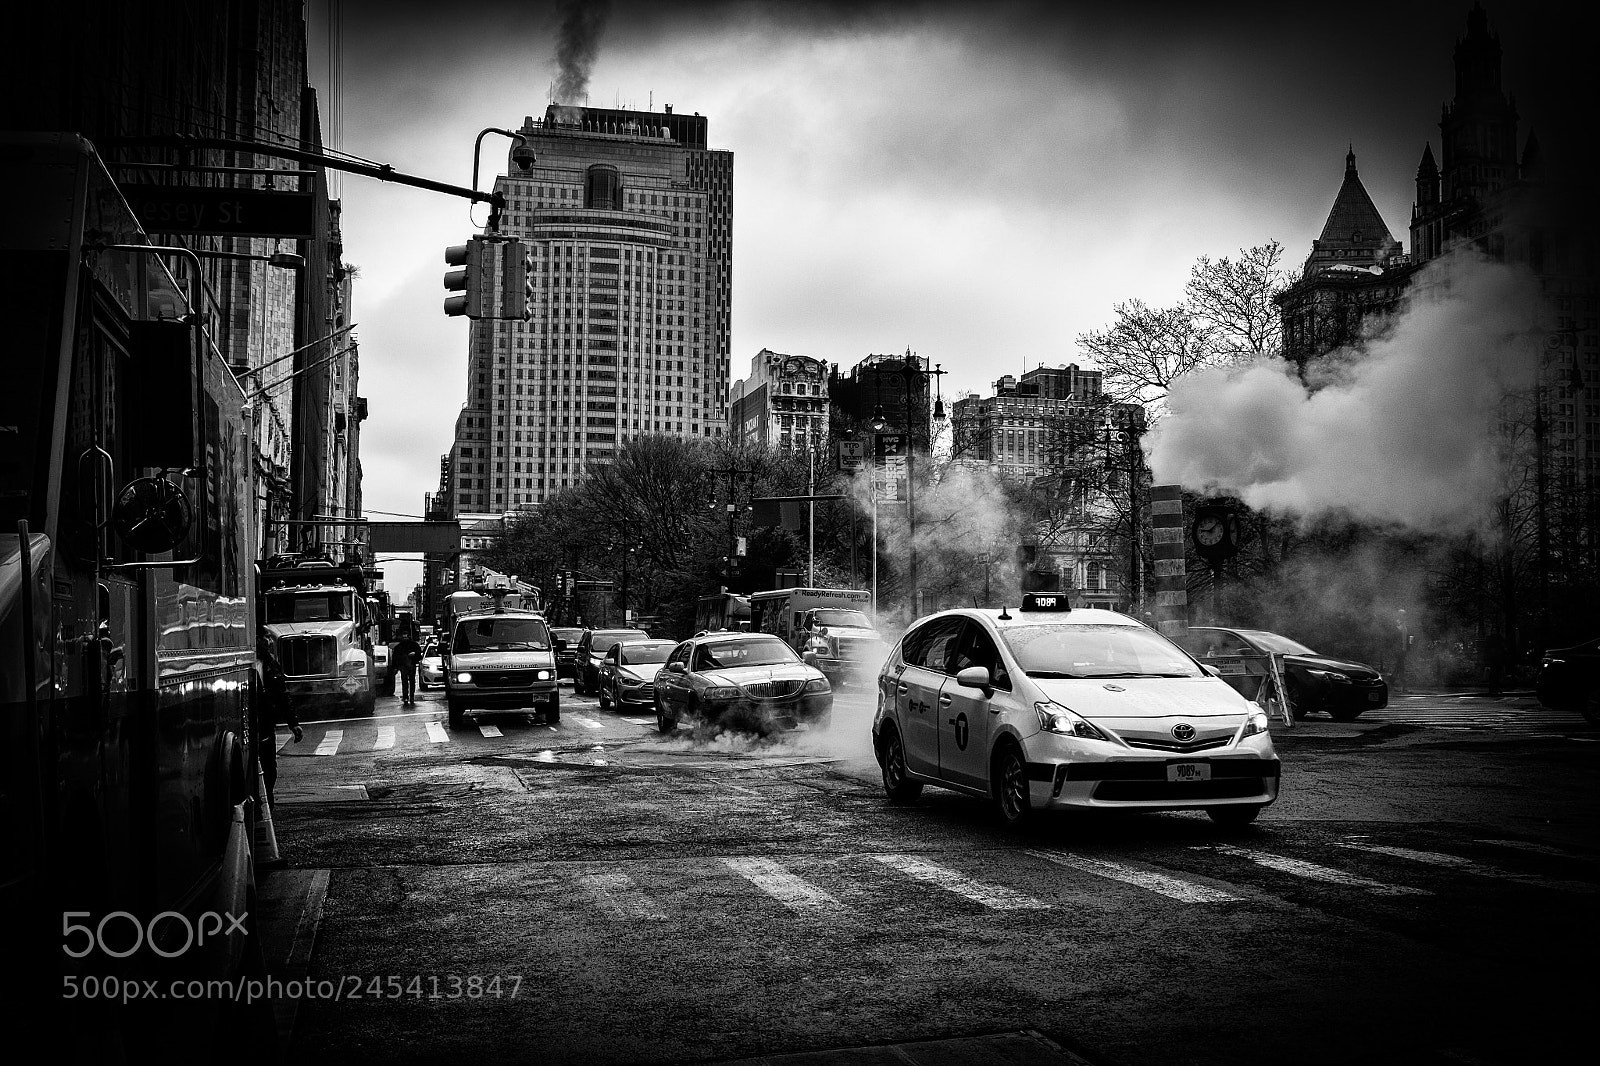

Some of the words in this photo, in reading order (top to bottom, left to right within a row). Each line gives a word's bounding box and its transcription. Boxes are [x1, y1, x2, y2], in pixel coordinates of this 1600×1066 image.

[217, 200, 245, 224] St
[885, 455, 897, 500] DESIGN
[801, 589, 861, 599] ReadyRefresh.com
